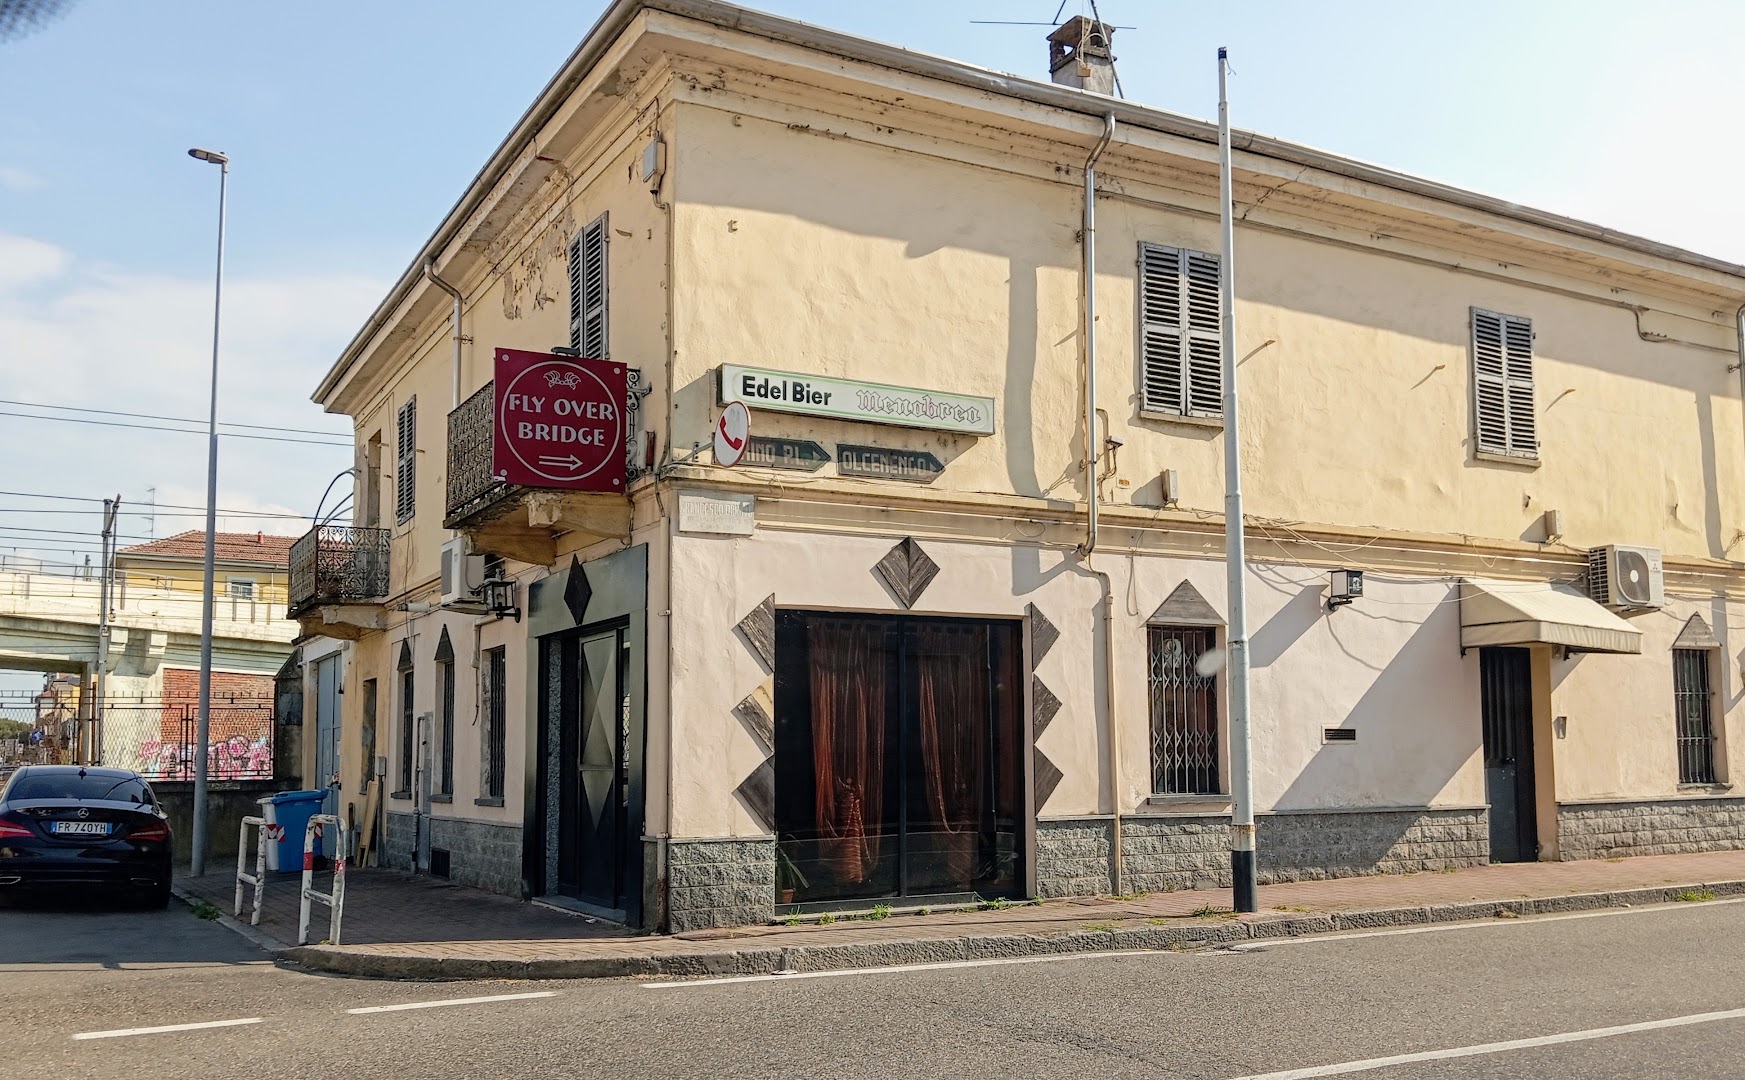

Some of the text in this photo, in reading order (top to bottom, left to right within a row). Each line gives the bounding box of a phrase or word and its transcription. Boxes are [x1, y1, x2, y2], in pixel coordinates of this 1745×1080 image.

[742, 375, 832, 406] Edel Bier
[509, 393, 614, 421] FLY OVER
[518, 421, 606, 447] BRIDGE
